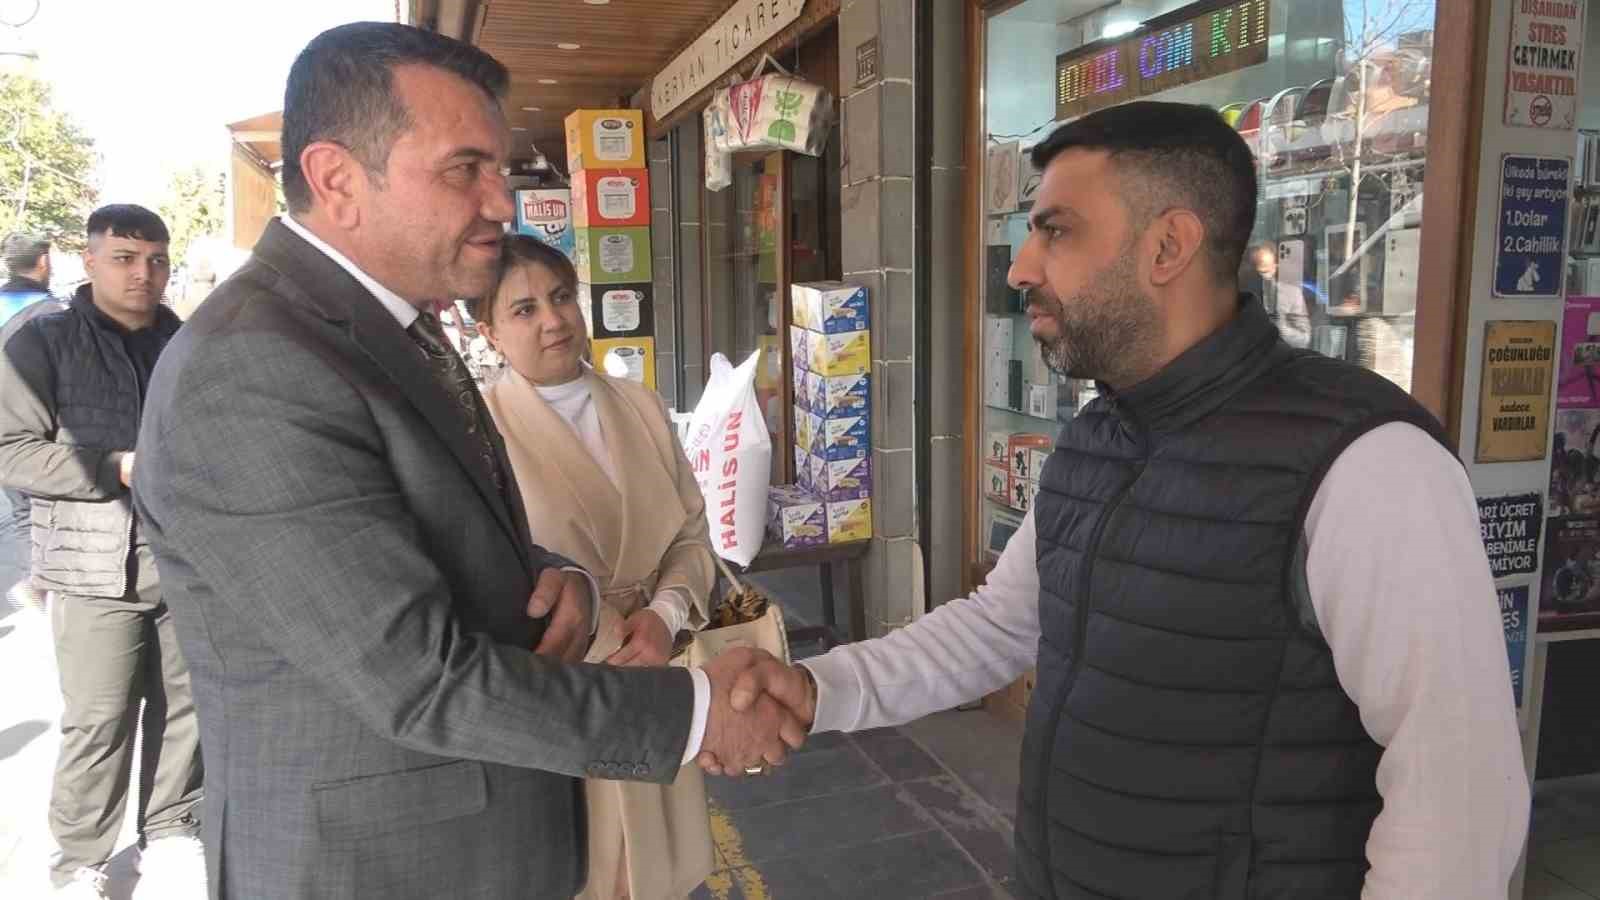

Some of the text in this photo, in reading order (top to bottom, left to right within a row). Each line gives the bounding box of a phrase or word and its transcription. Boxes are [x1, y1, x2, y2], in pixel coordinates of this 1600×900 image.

[1528, 22, 1567, 45] STRES
[1506, 210, 1548, 226] 1.Dolar
[1504, 235, 1560, 254] 2.Cahillik
[1500, 502, 1536, 518] ÜCRET
